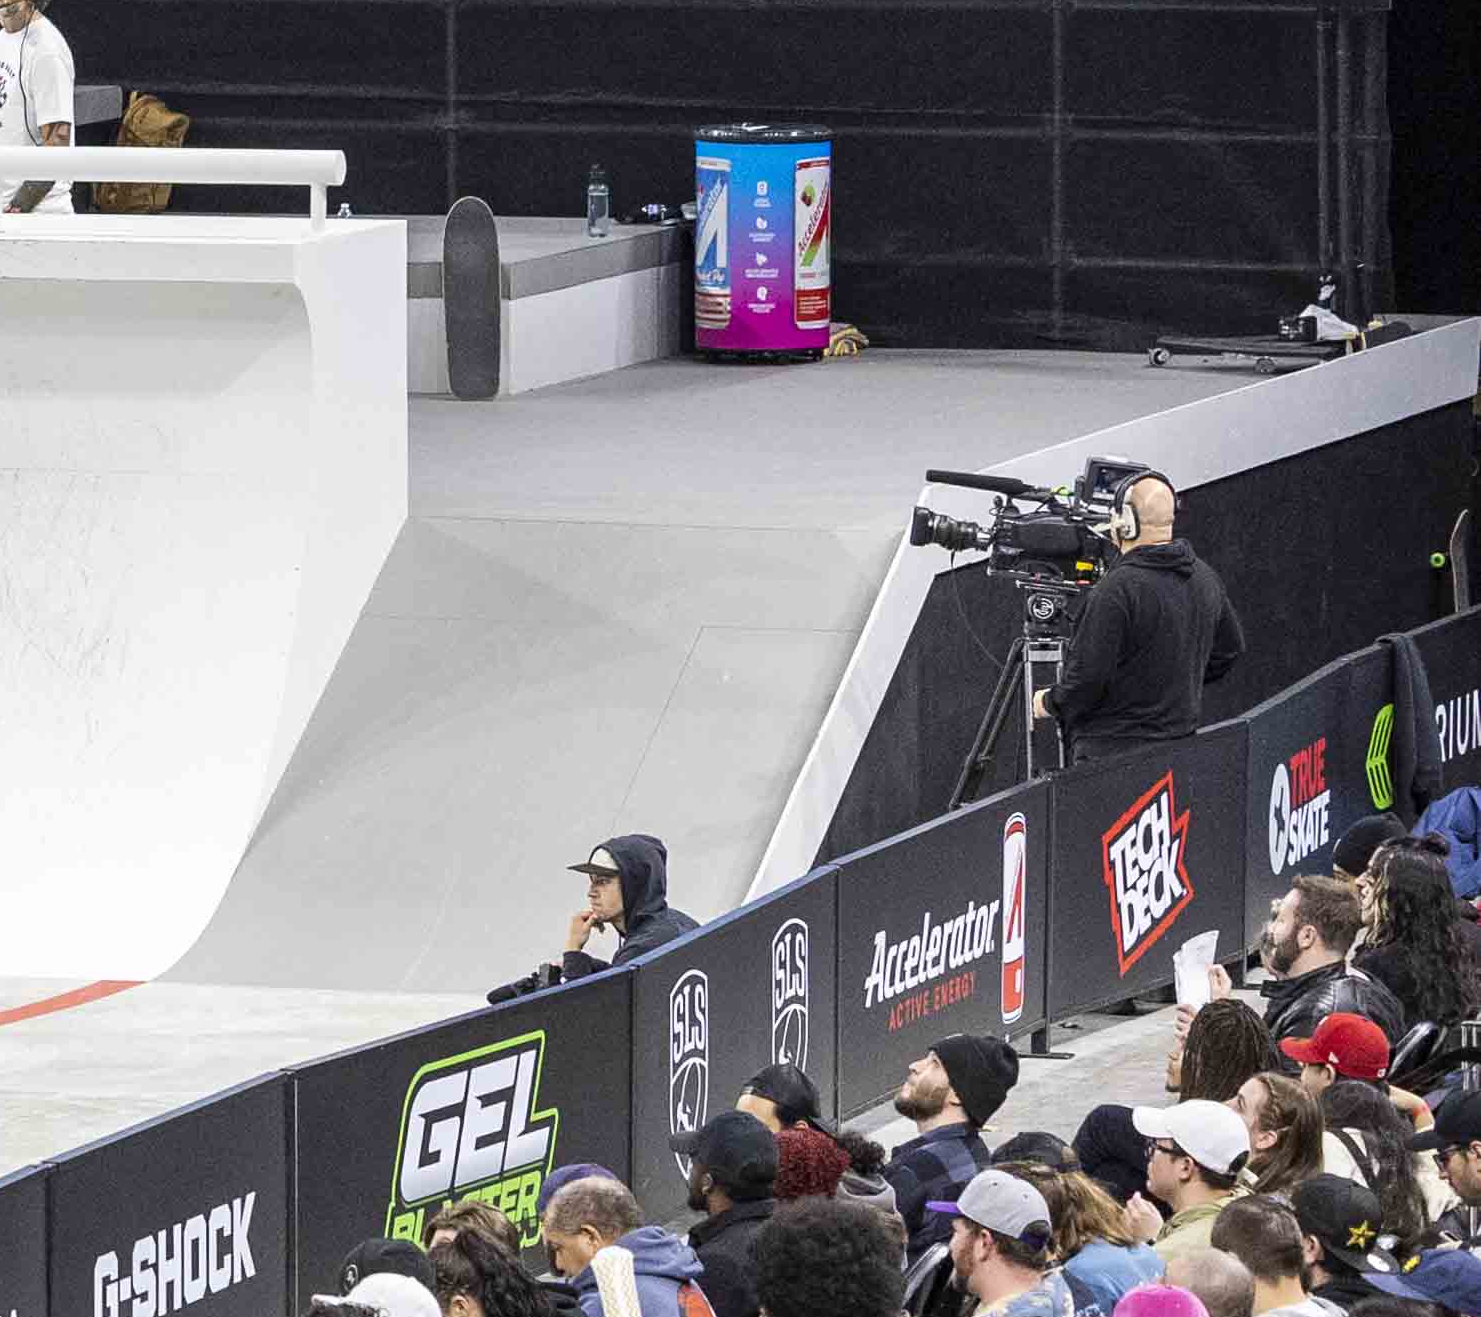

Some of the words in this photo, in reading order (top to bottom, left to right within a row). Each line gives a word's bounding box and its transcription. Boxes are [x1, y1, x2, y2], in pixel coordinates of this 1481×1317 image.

[1289, 737, 1326, 808] TRUE
[1108, 791, 1171, 895] TECH
[1287, 789, 1331, 866] SKATE
[775, 928, 807, 1011] SLS
[888, 994, 931, 1034] ACTIVE
[933, 973, 975, 1017] ENERGY
[672, 980, 706, 1063] SLS
[400, 1049, 552, 1203] GEL
